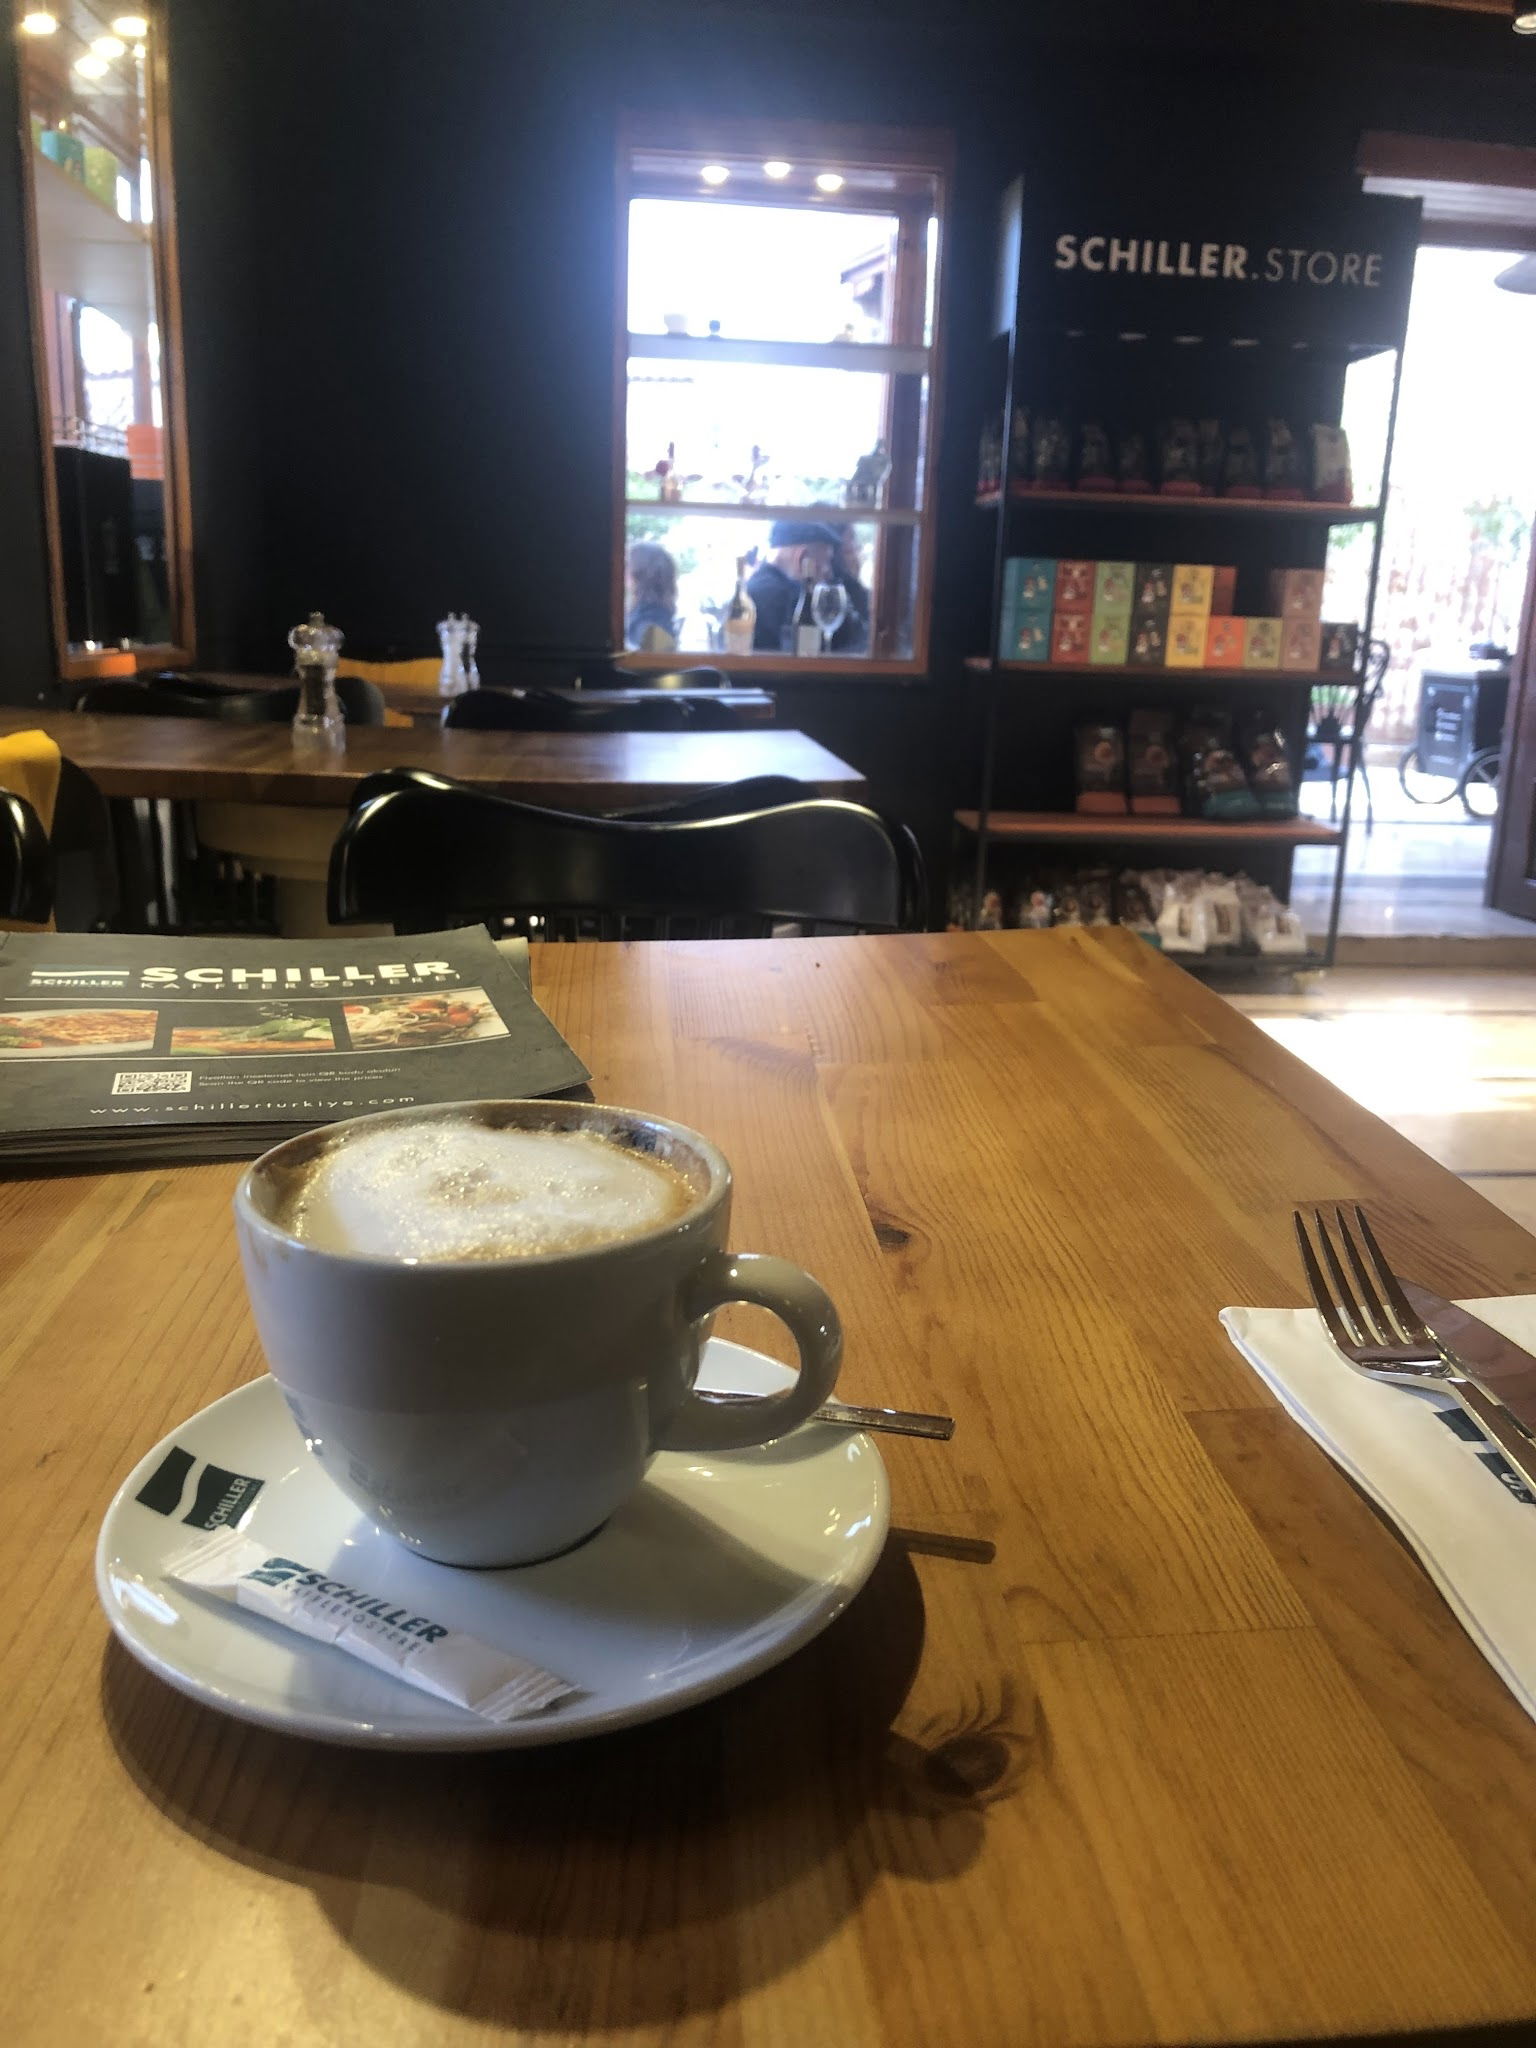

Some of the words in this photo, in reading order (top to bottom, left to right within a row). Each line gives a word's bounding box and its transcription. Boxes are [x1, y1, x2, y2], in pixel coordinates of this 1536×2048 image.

[1055, 234, 1383, 288] SCHILLER.STORE
[30, 978, 124, 989] SCHILLER
[141, 961, 456, 983] SCHILLER
[204, 1478, 251, 1530] SCHILLER
[297, 1573, 449, 1643] SCHILLER
